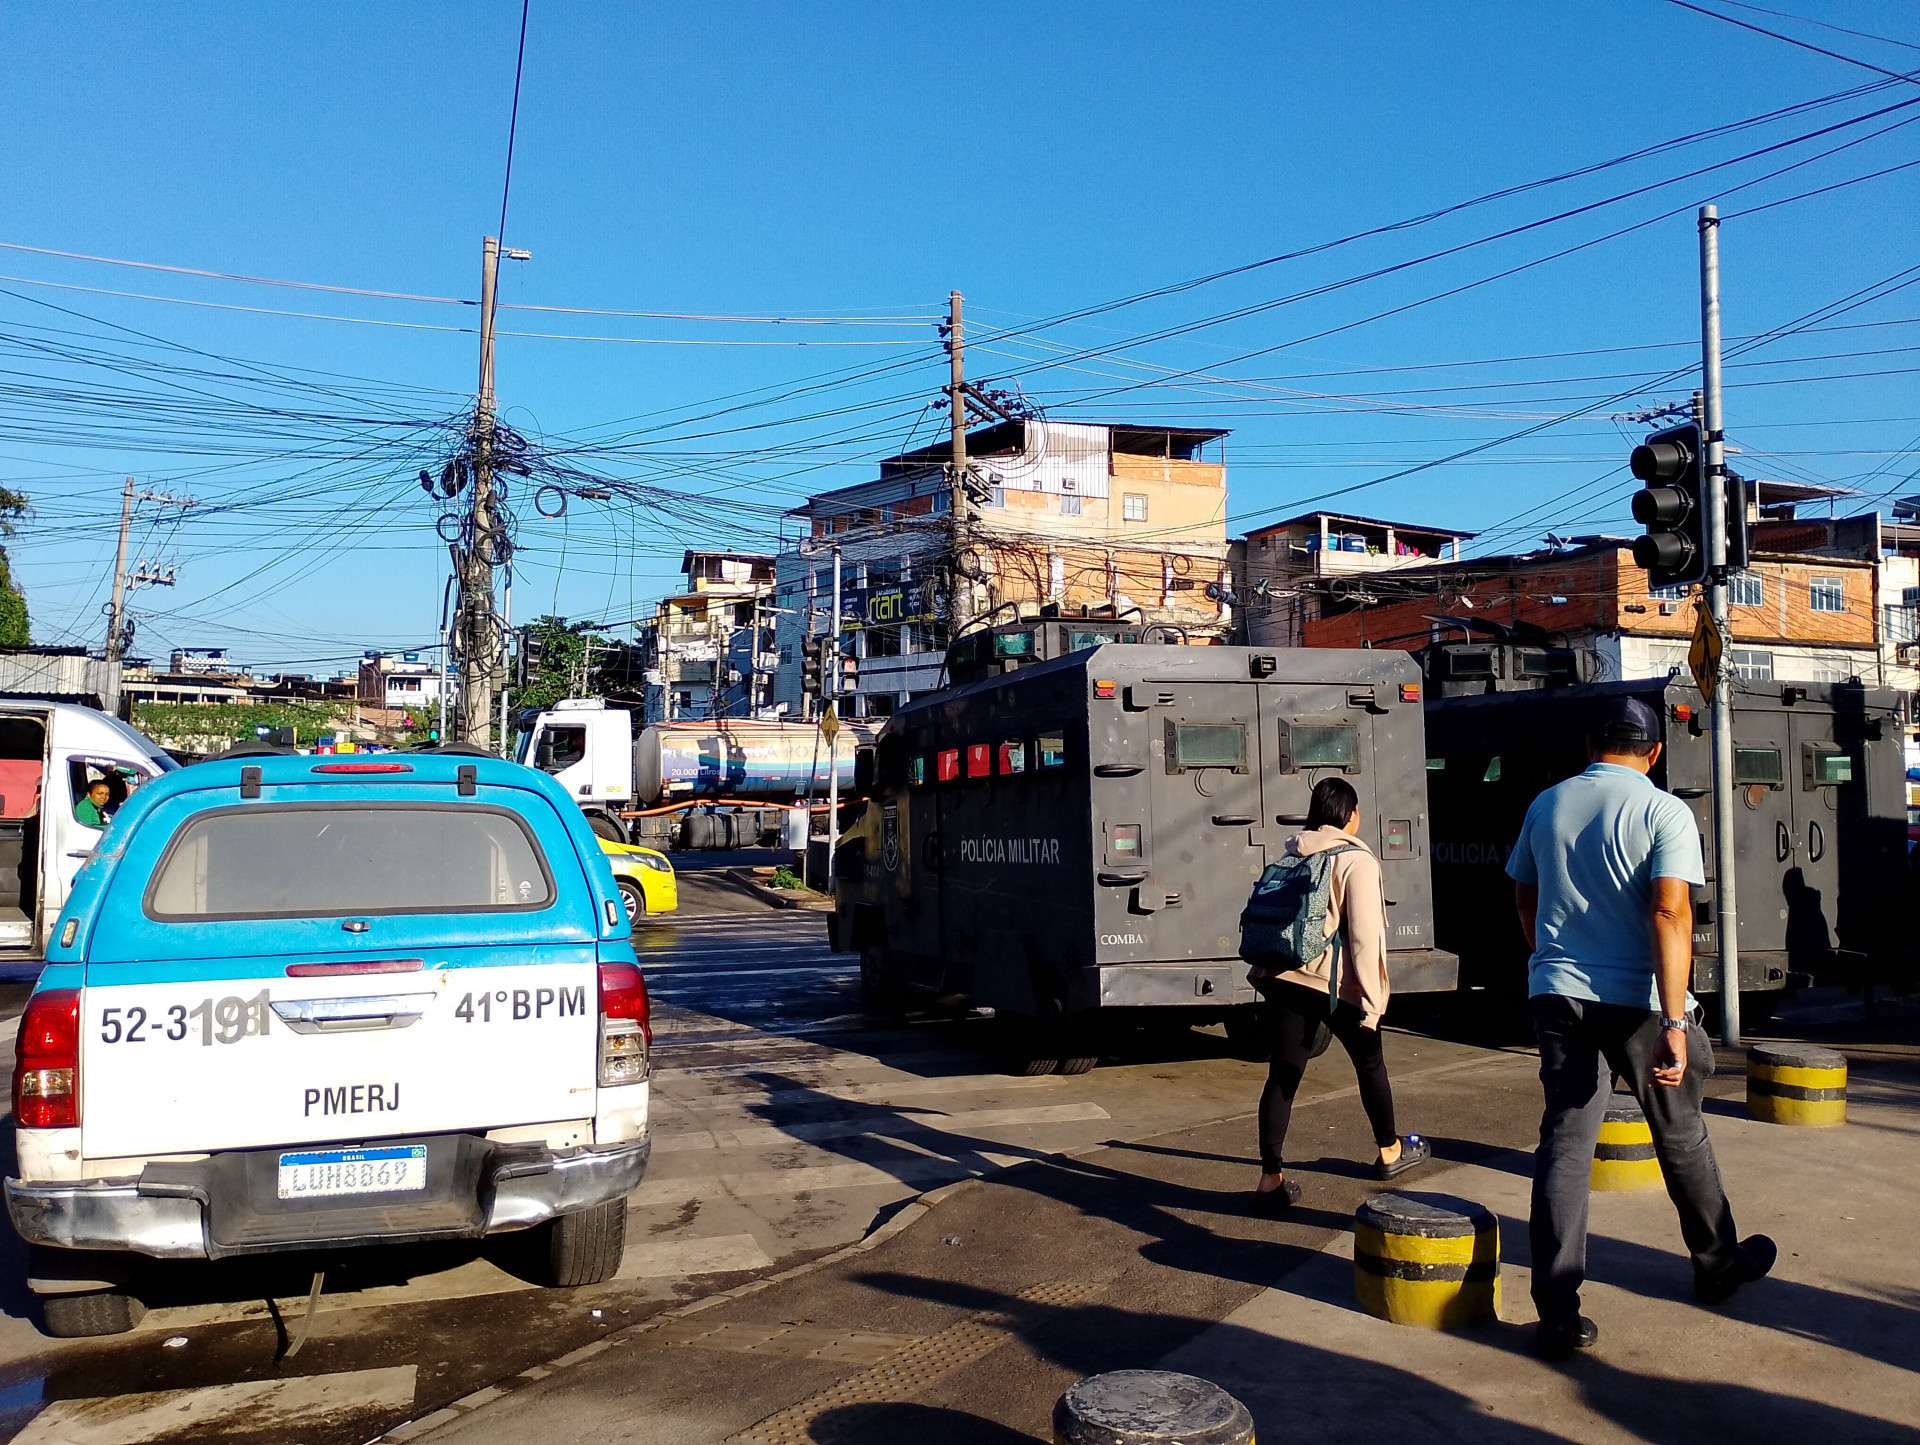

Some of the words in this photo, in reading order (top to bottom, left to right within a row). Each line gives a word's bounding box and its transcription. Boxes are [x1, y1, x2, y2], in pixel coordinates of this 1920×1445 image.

[671, 768, 698, 776] 20.000
[700, 768, 721, 776] Litros
[961, 834, 1005, 863] POLÍCIA
[1008, 838, 1060, 864] MILITAR
[304, 1082, 400, 1117] PMERJ
